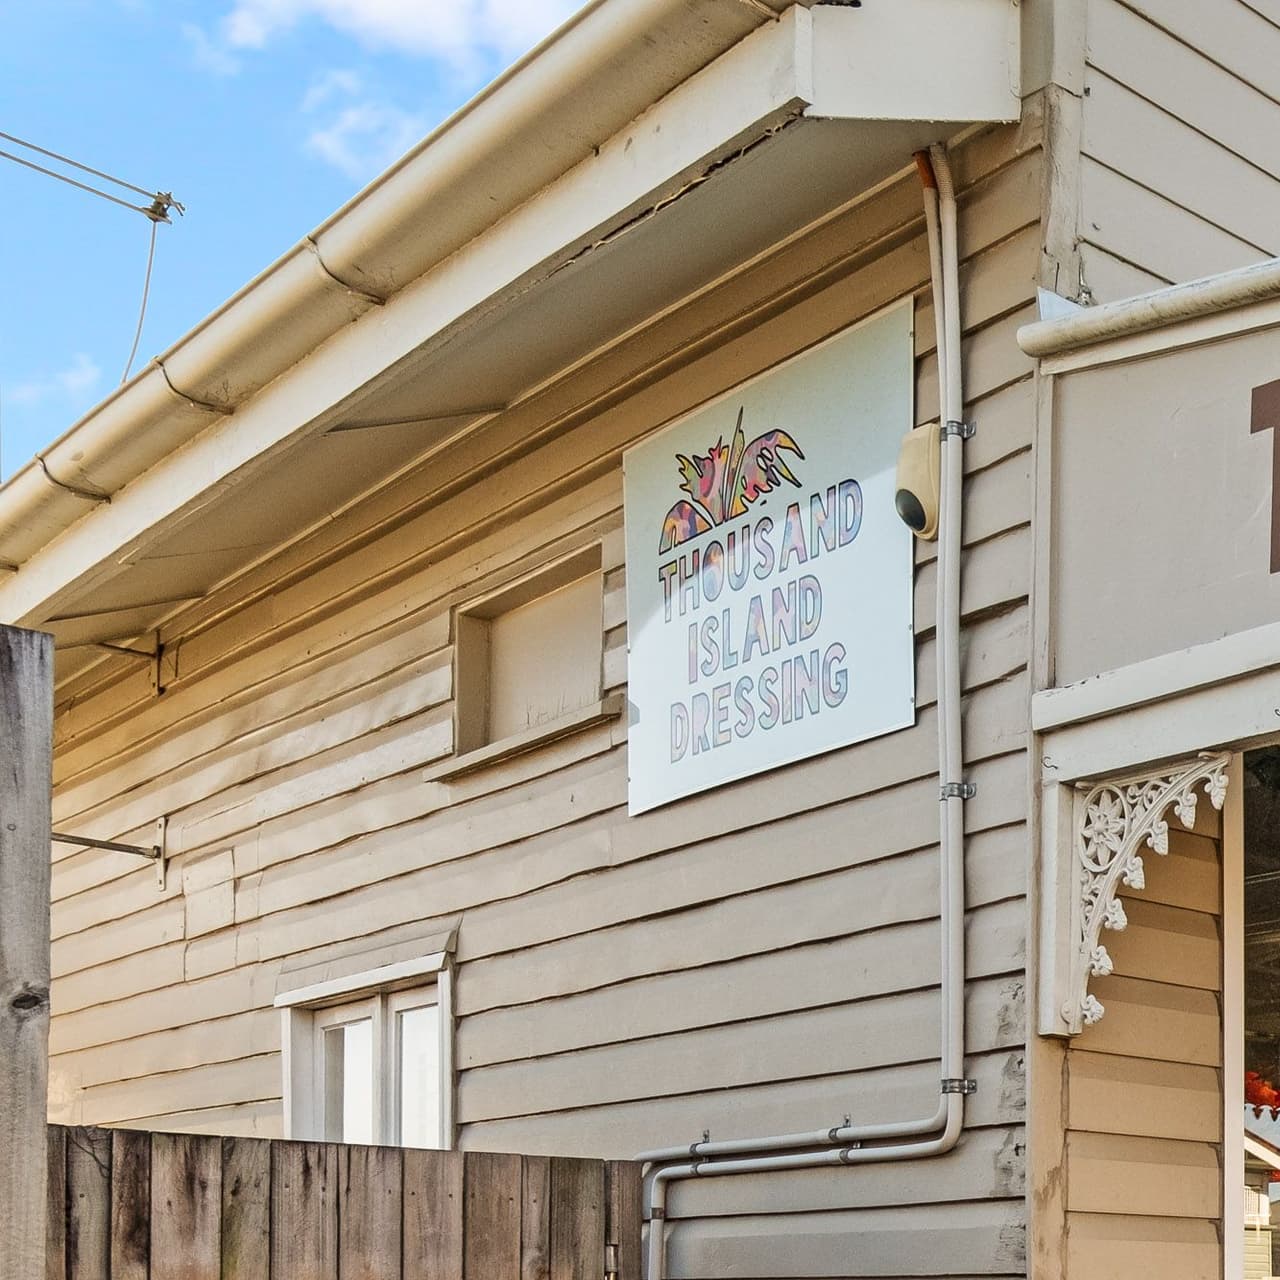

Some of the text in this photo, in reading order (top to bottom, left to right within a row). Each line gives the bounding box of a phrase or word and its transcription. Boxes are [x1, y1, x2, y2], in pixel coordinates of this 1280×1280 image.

[658, 478, 864, 624] THOUSAND
[688, 574, 823, 684] ISLAND
[670, 642, 849, 764] DRESSING
